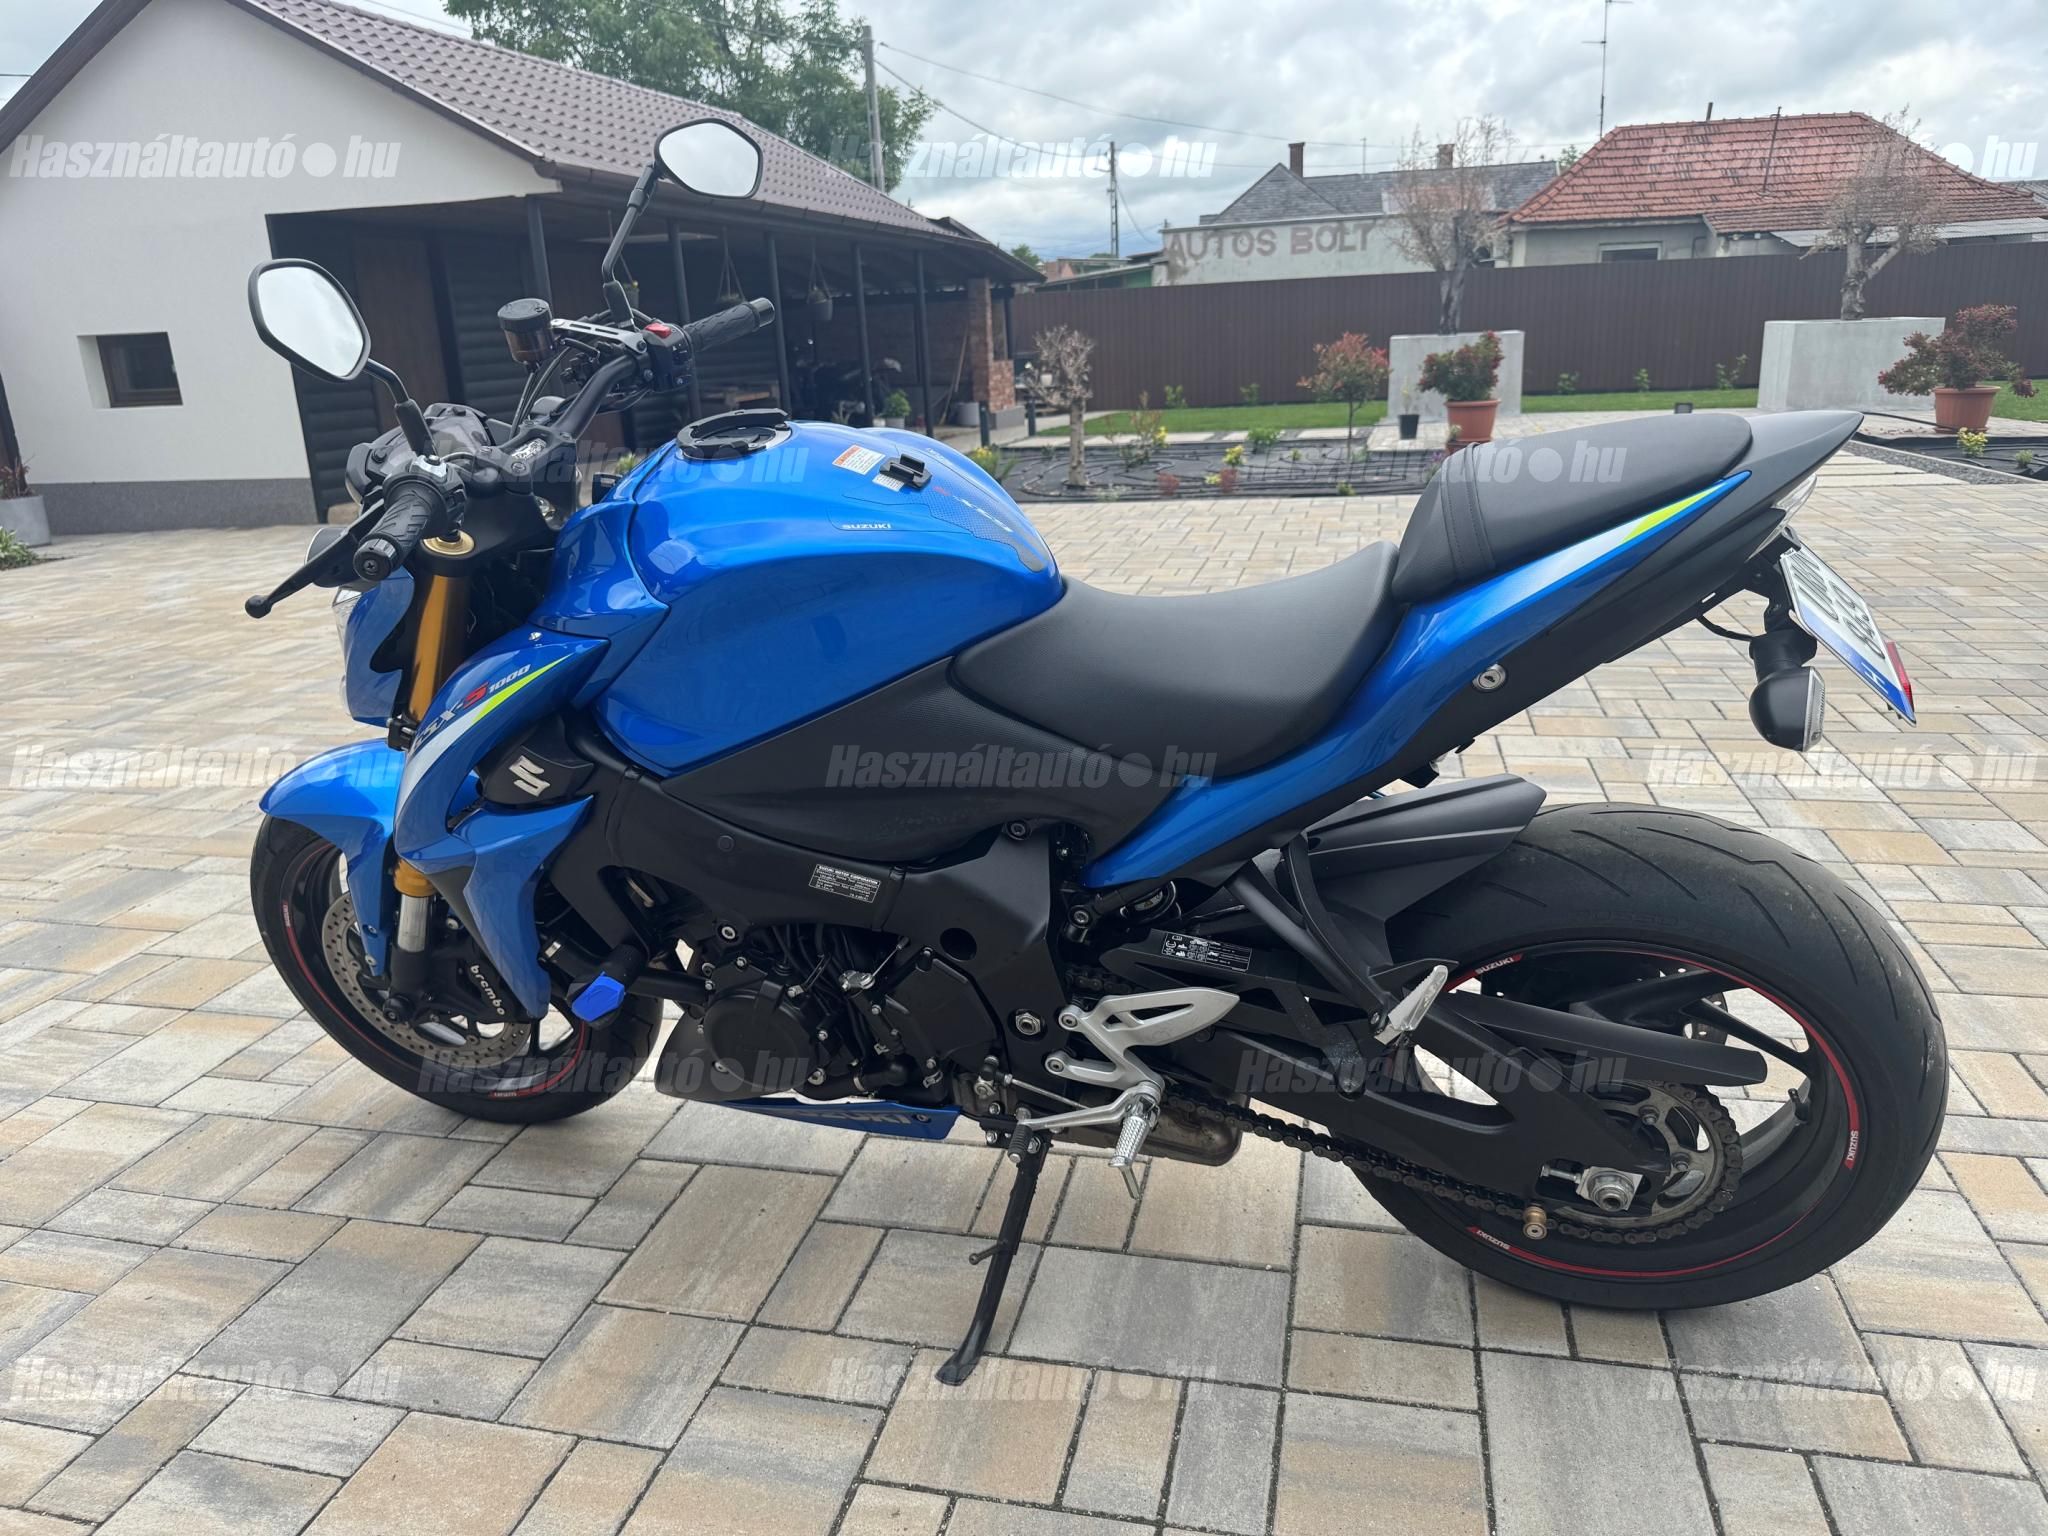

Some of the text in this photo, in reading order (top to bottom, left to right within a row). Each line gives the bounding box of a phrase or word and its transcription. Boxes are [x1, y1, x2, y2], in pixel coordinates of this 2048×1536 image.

[1167, 220, 1376, 263] AUTOS BOLT
[489, 664, 531, 693] 1000
[1475, 956, 1514, 975] SUZUKI
[470, 964, 505, 1015] brembo
[1846, 1130, 1859, 1161] SUZUKI
